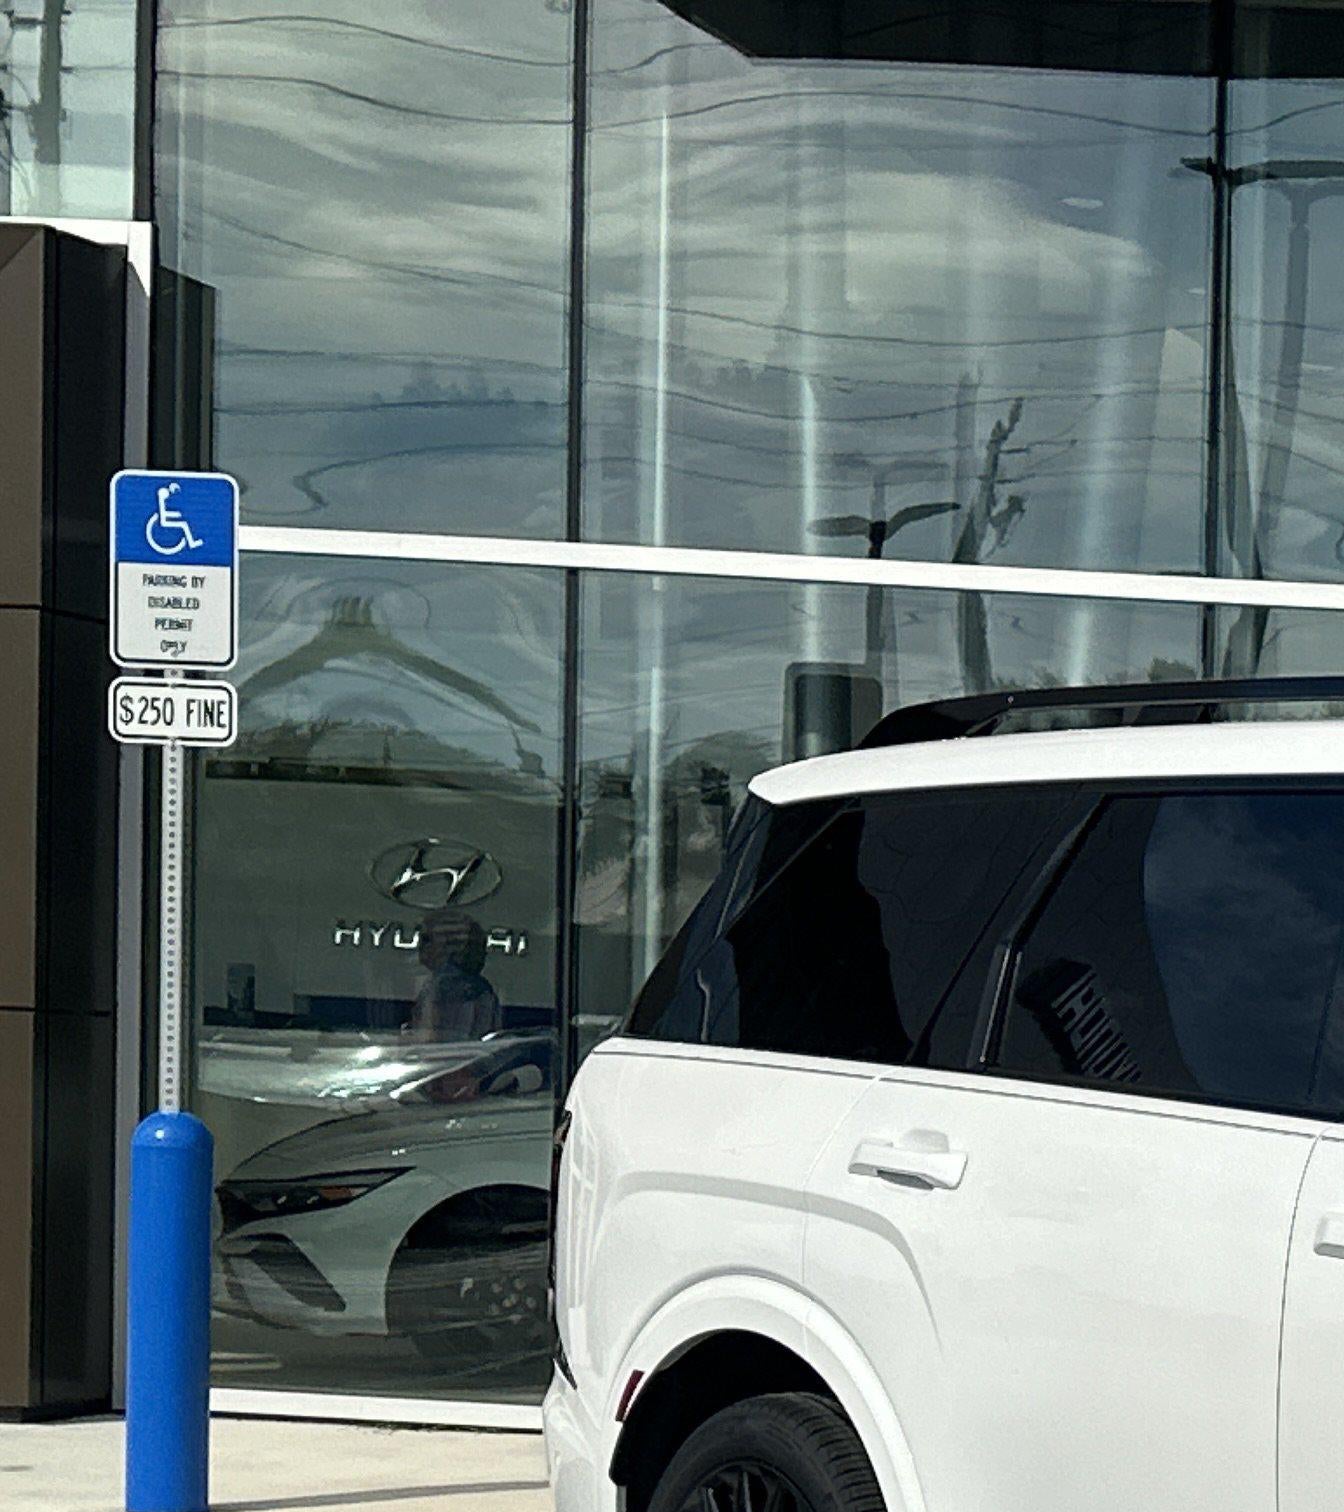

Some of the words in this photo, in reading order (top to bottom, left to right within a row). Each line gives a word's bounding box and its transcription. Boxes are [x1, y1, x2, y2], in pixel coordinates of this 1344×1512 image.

[143, 574, 187, 588] PARKING
[191, 576, 206, 589] BY
[148, 596, 200, 609] DISABLED
[119, 693, 174, 726] $250
[186, 698, 227, 728] FINE
[334, 918, 529, 956] HYUAI
